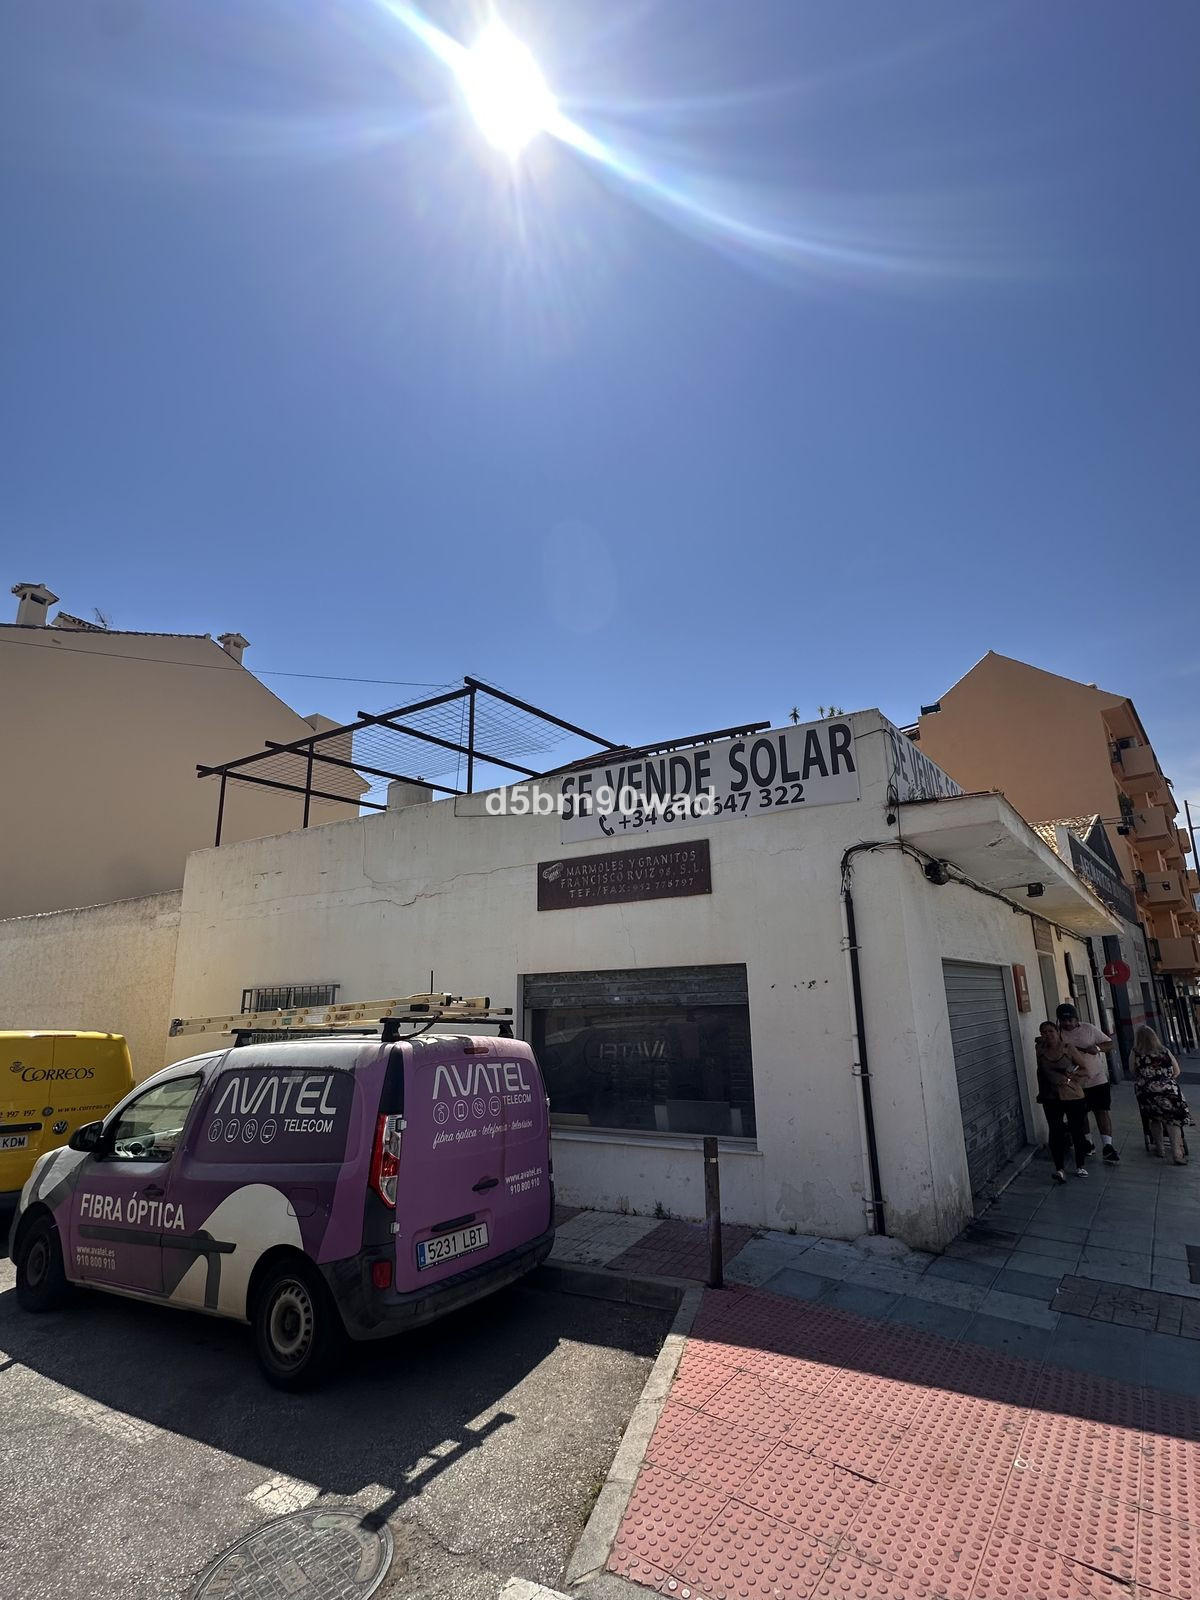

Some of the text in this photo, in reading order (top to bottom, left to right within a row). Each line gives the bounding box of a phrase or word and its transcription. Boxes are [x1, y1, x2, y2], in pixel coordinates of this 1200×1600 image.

[561, 723, 856, 820] SE VENDE SOLAR
[618, 810, 658, 830] +34
[710, 791, 752, 816] 647
[759, 783, 805, 808] 322
[638, 850, 697, 868] GRANITOS
[560, 871, 624, 889] FRANCISCO
[21, 1067, 95, 1082] CORREOS
[432, 1062, 531, 1100] AVATEL
[214, 1074, 337, 1115] AVATEL
[502, 1093, 532, 1105] TELECOM
[283, 1119, 334, 1133] TELECOM
[2, 1136, 26, 1148] KDM
[432, 1131, 454, 1150] fibra
[510, 1183, 521, 1195] 910
[80, 1191, 185, 1230] FIBRA ÓPTICA
[427, 1235, 458, 1260] 5231
[462, 1227, 482, 1249] LBT
